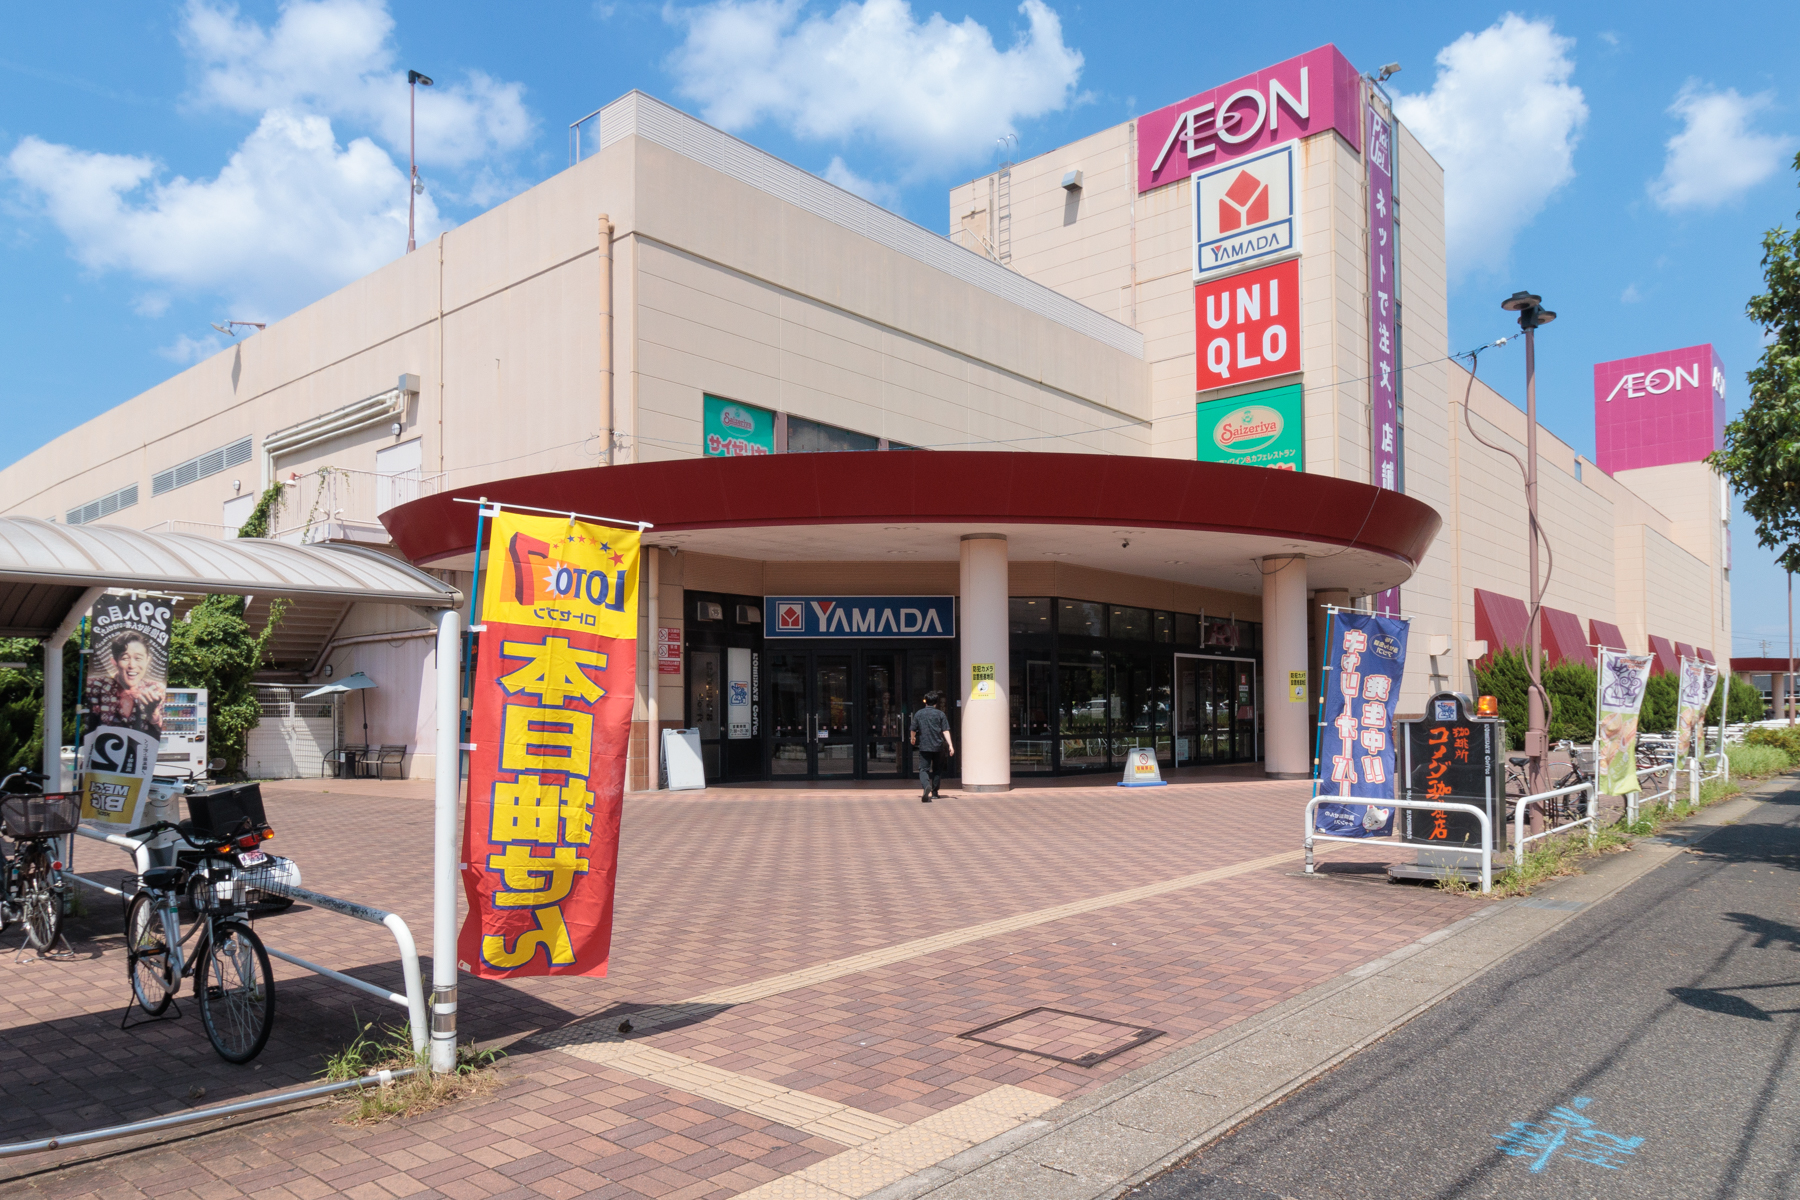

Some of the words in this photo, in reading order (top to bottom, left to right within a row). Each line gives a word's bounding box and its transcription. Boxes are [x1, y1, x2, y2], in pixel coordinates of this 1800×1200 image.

[1210, 232, 1280, 262] YAMADA
[1206, 279, 1279, 329] UNI
[1207, 324, 1287, 378] QLO
[1219, 421, 1277, 445] Saizeriya
[810, 601, 944, 633] YAMADA
[973, 665, 994, 673] 防犯カメラ
